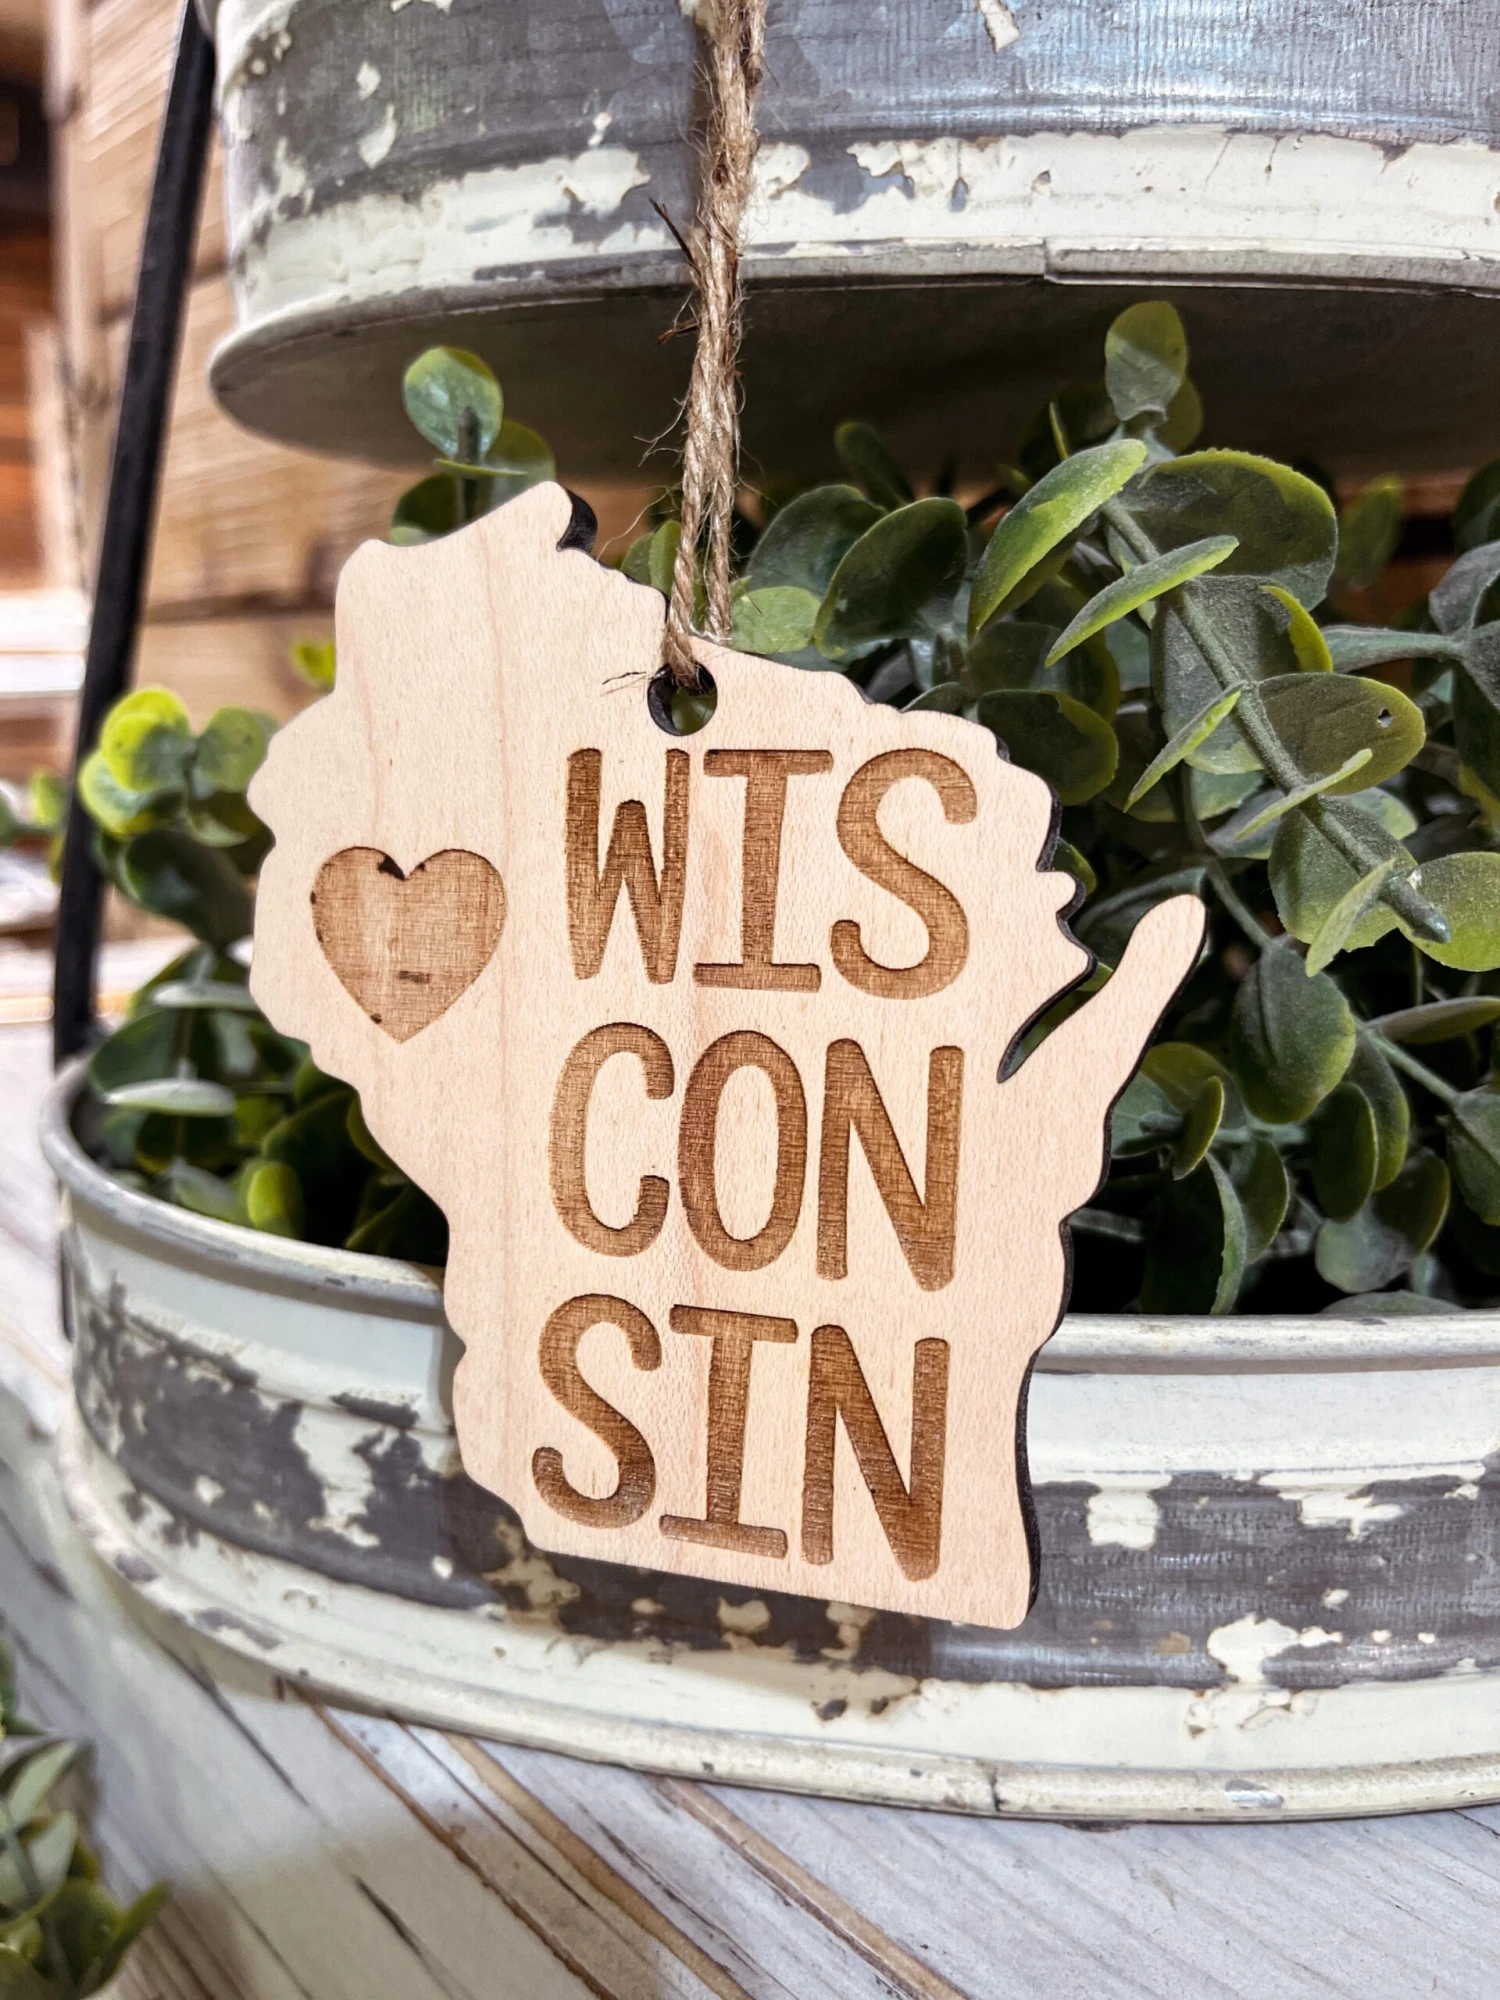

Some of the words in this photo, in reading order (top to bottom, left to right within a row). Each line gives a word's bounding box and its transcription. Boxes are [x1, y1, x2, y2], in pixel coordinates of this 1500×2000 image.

[564, 747, 977, 1000] WIS
[548, 1021, 964, 1292] CON
[531, 1293, 951, 1582] SIN
